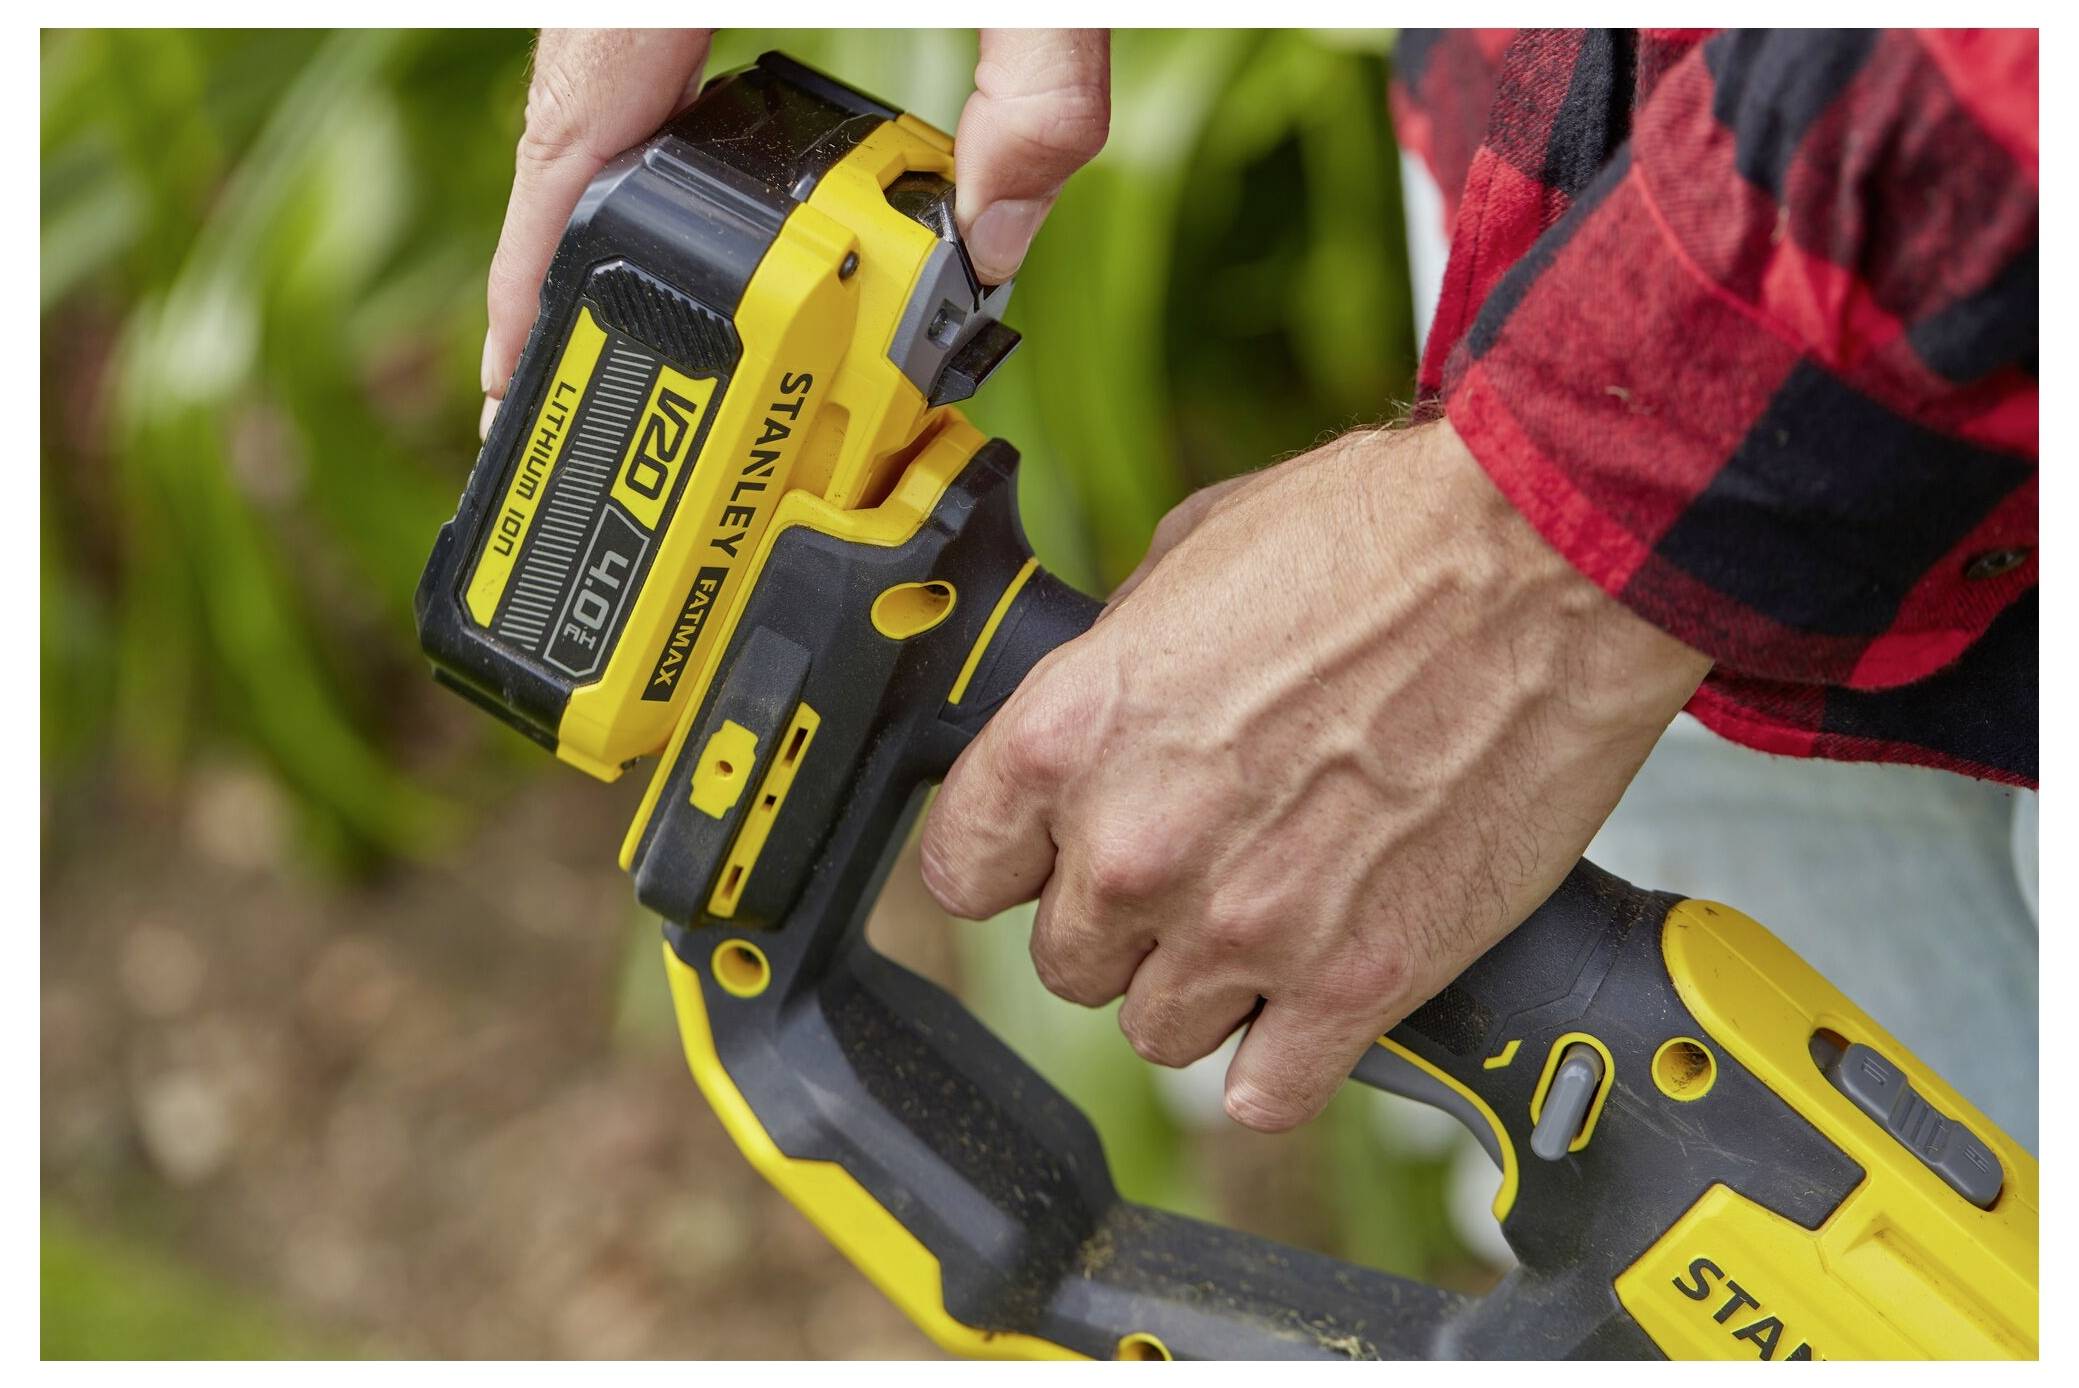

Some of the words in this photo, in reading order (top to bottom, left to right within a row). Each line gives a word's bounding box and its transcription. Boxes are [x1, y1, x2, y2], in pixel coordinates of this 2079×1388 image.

[624, 387, 698, 501] V20
[710, 372, 814, 559] STANLEY
[573, 550, 630, 631] 4.0
[653, 579, 718, 687] FATMAX
[1672, 1258, 1827, 1361] STA
